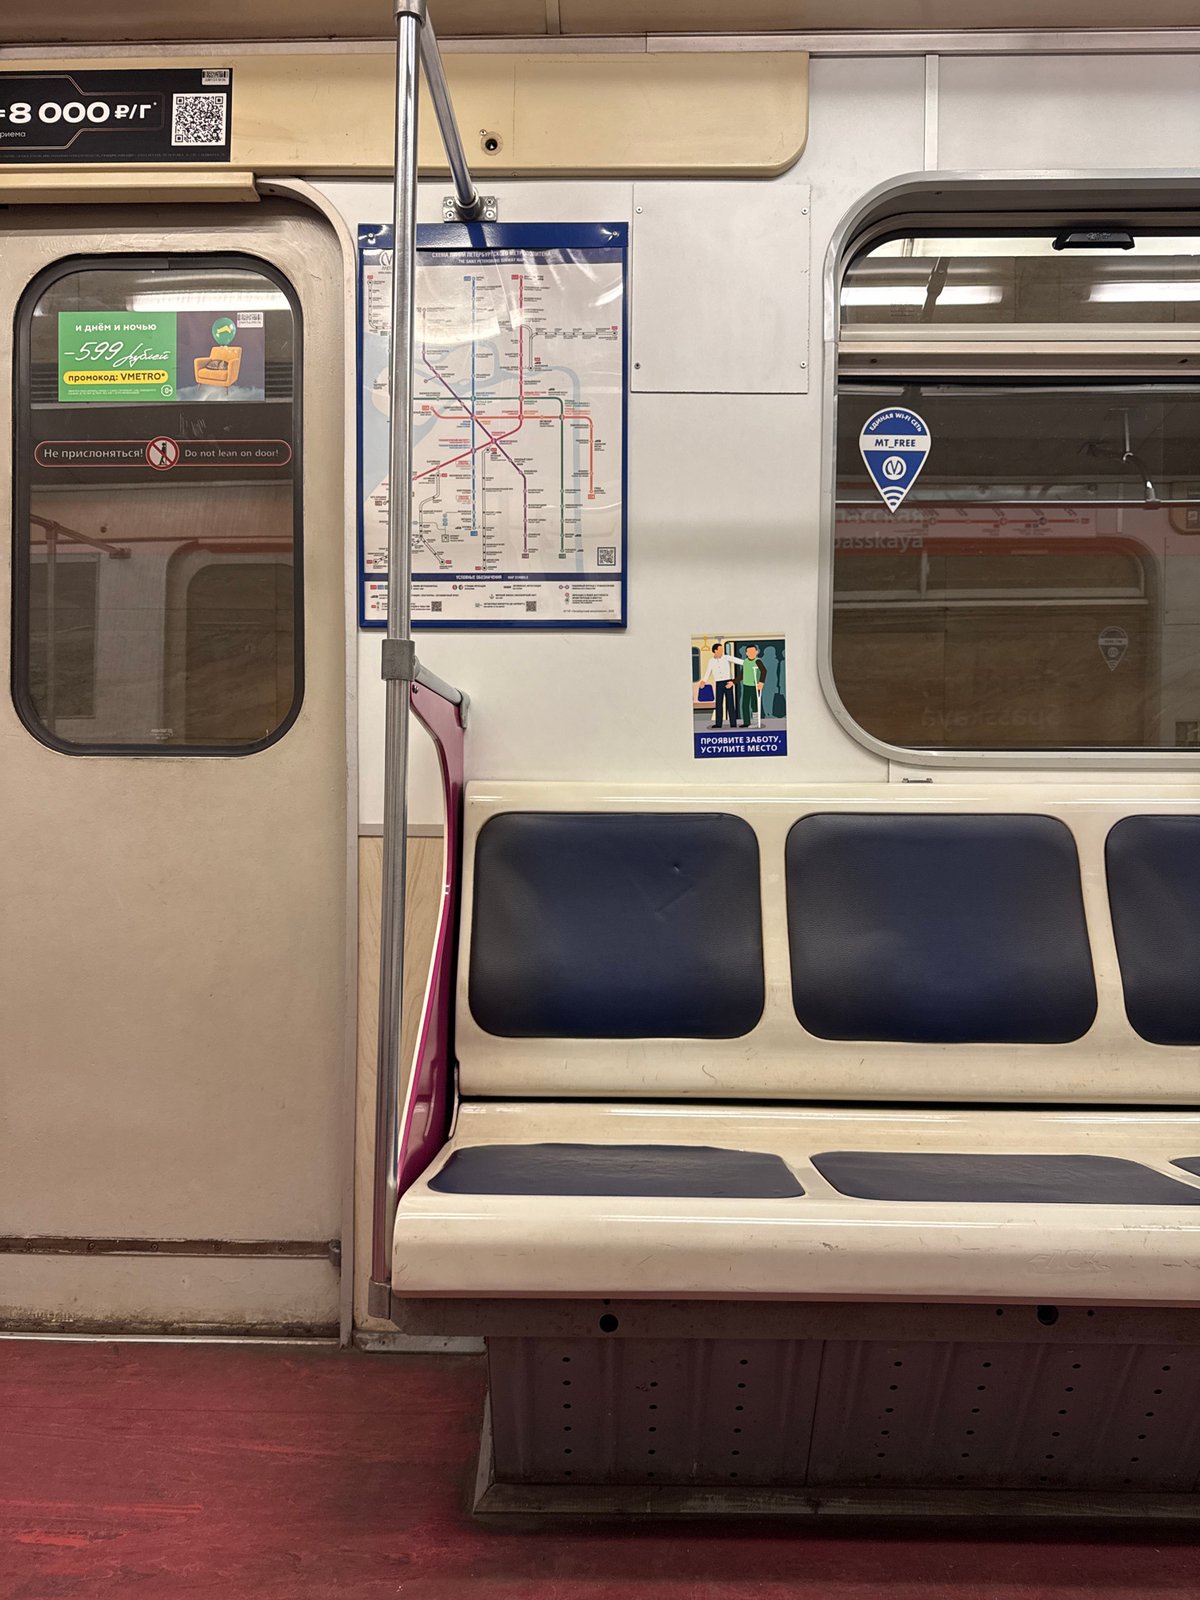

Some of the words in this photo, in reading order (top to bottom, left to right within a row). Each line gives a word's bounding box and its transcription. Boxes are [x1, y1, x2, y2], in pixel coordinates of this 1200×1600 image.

[38, 101, 111, 124] 000
[84, 323, 111, 332] днём
[112, 343, 171, 368] рублей
[68, 374, 118, 383] промокод:
[869, 412, 894, 431] ЕДИНАЯ
[910, 419, 922, 433] СЕТЬ
[874, 438, 916, 449] MT_FREE
[43, 448, 59, 458] Не
[61, 447, 144, 461] прислоняться!
[184, 449, 197, 458] Do
[200, 449, 215, 458] not
[218, 448, 237, 458] lean
[240, 450, 253, 458] on
[254, 448, 279, 458] door!
[700, 737, 744, 745] ПРОЯВИТЕ
[745, 735, 782, 744] ЗАБОТУ,
[700, 744, 745, 753] УСТУПИТЕ
[747, 744, 778, 752] МЕСТО
